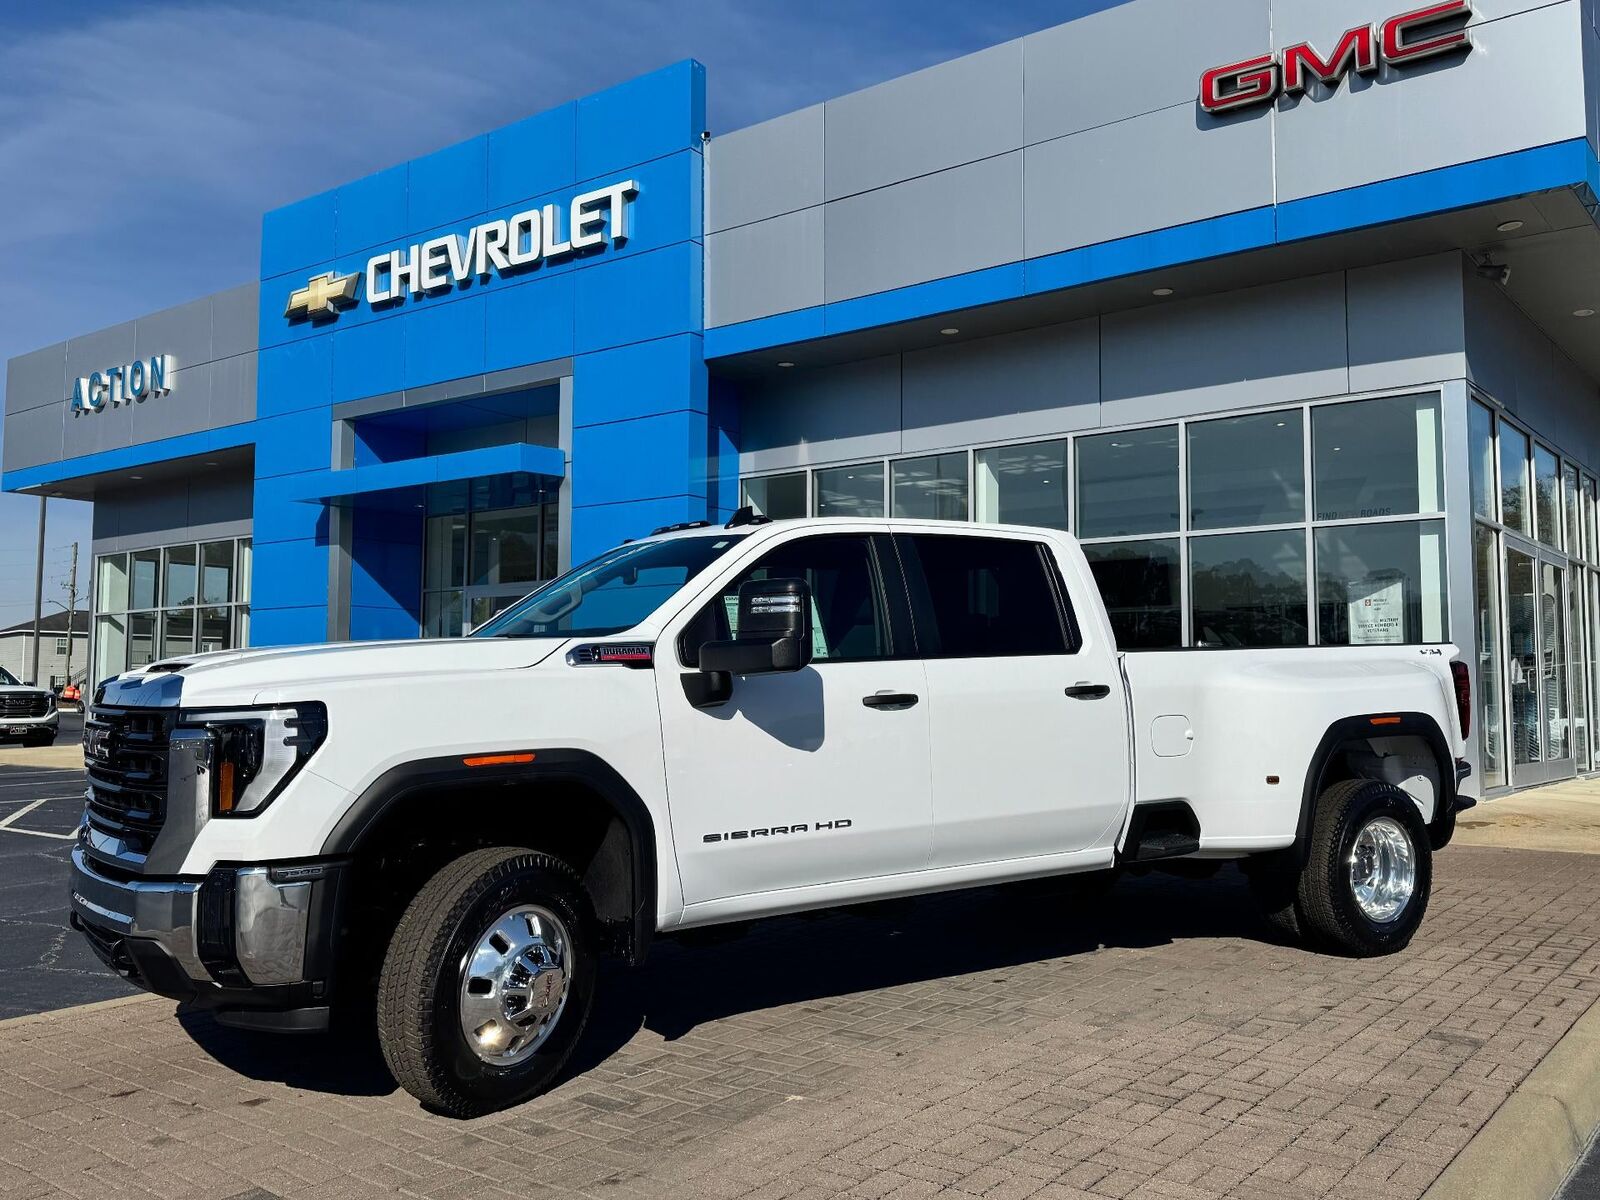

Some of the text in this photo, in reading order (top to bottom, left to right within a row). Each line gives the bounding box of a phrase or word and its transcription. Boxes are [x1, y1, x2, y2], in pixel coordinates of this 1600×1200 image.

[1198, 0, 1474, 113] GMC
[366, 179, 640, 305] CHEVROLET
[70, 354, 172, 413] ACTION
[1317, 511, 1338, 521] FIND
[1360, 507, 1392, 518] ROADS
[603, 647, 647, 655] DURAMAX
[702, 819, 852, 843] SIERRA HD
